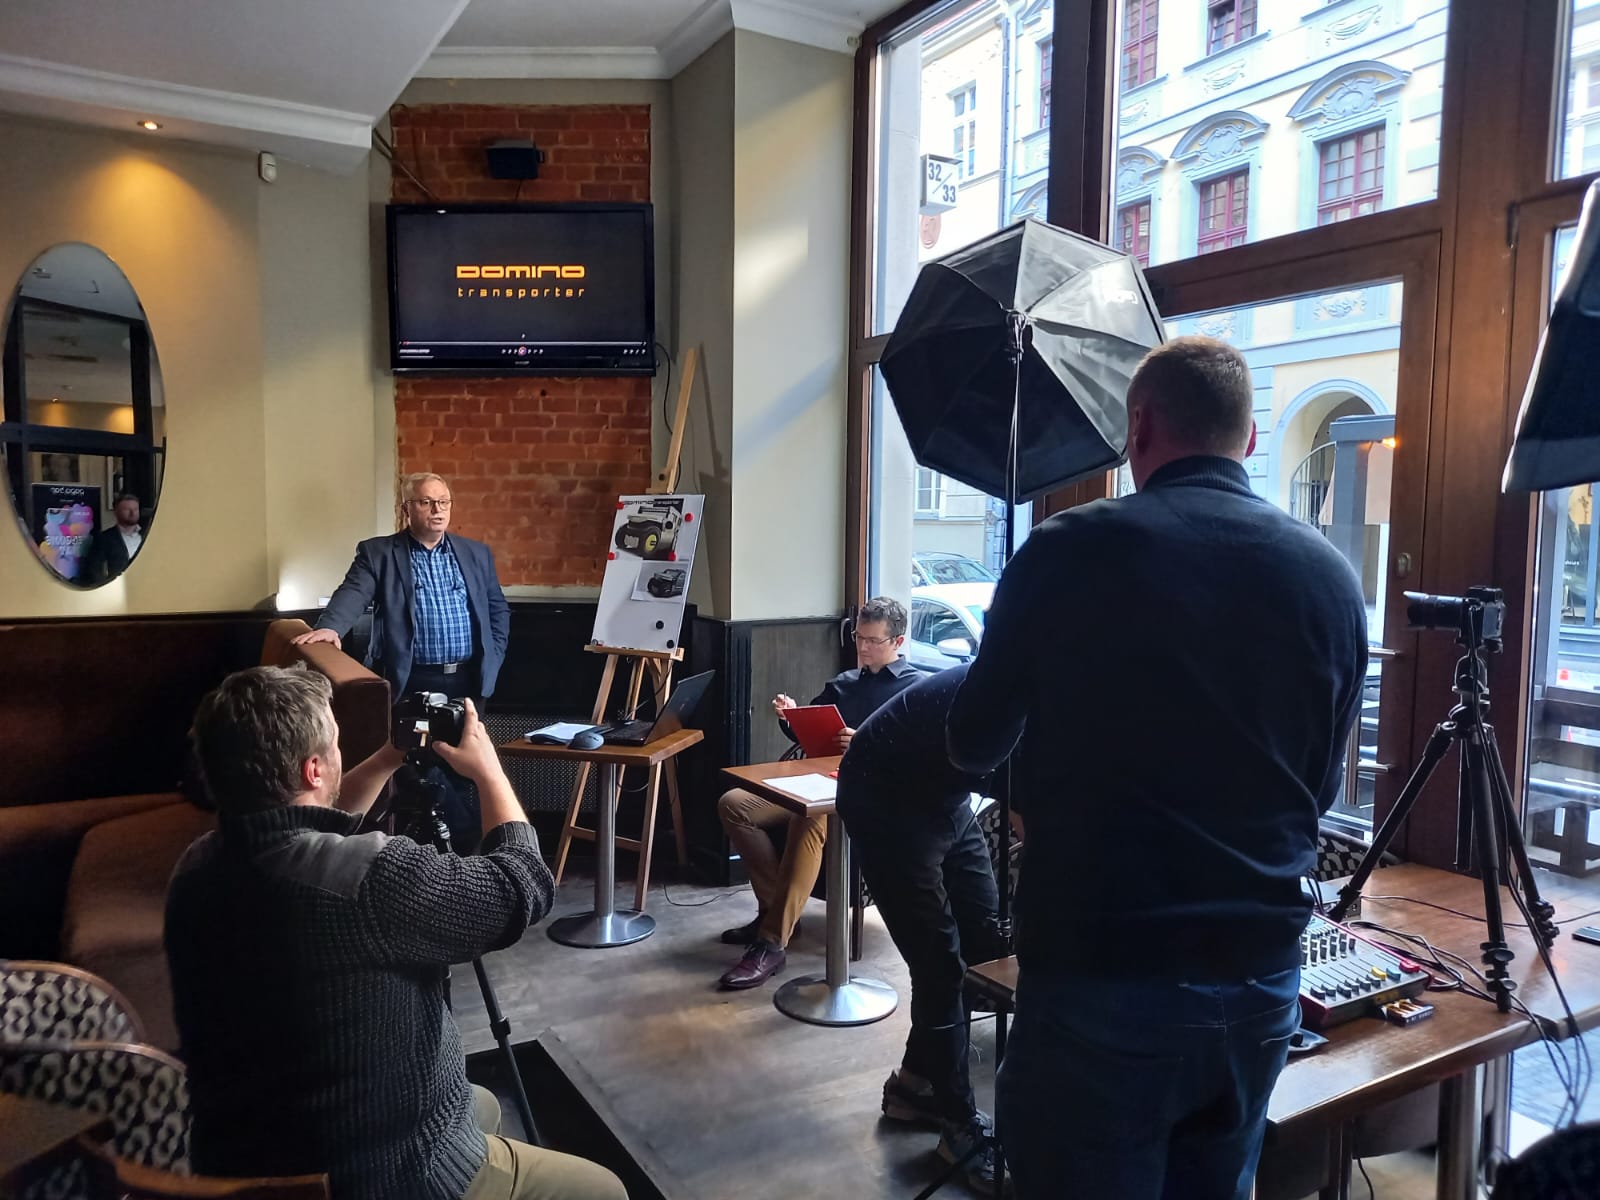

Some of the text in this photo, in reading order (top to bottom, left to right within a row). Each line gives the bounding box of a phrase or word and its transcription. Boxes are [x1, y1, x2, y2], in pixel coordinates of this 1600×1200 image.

[928, 162, 942, 181] 32
[943, 184, 957, 203] 33
[457, 287, 585, 299] transporter
